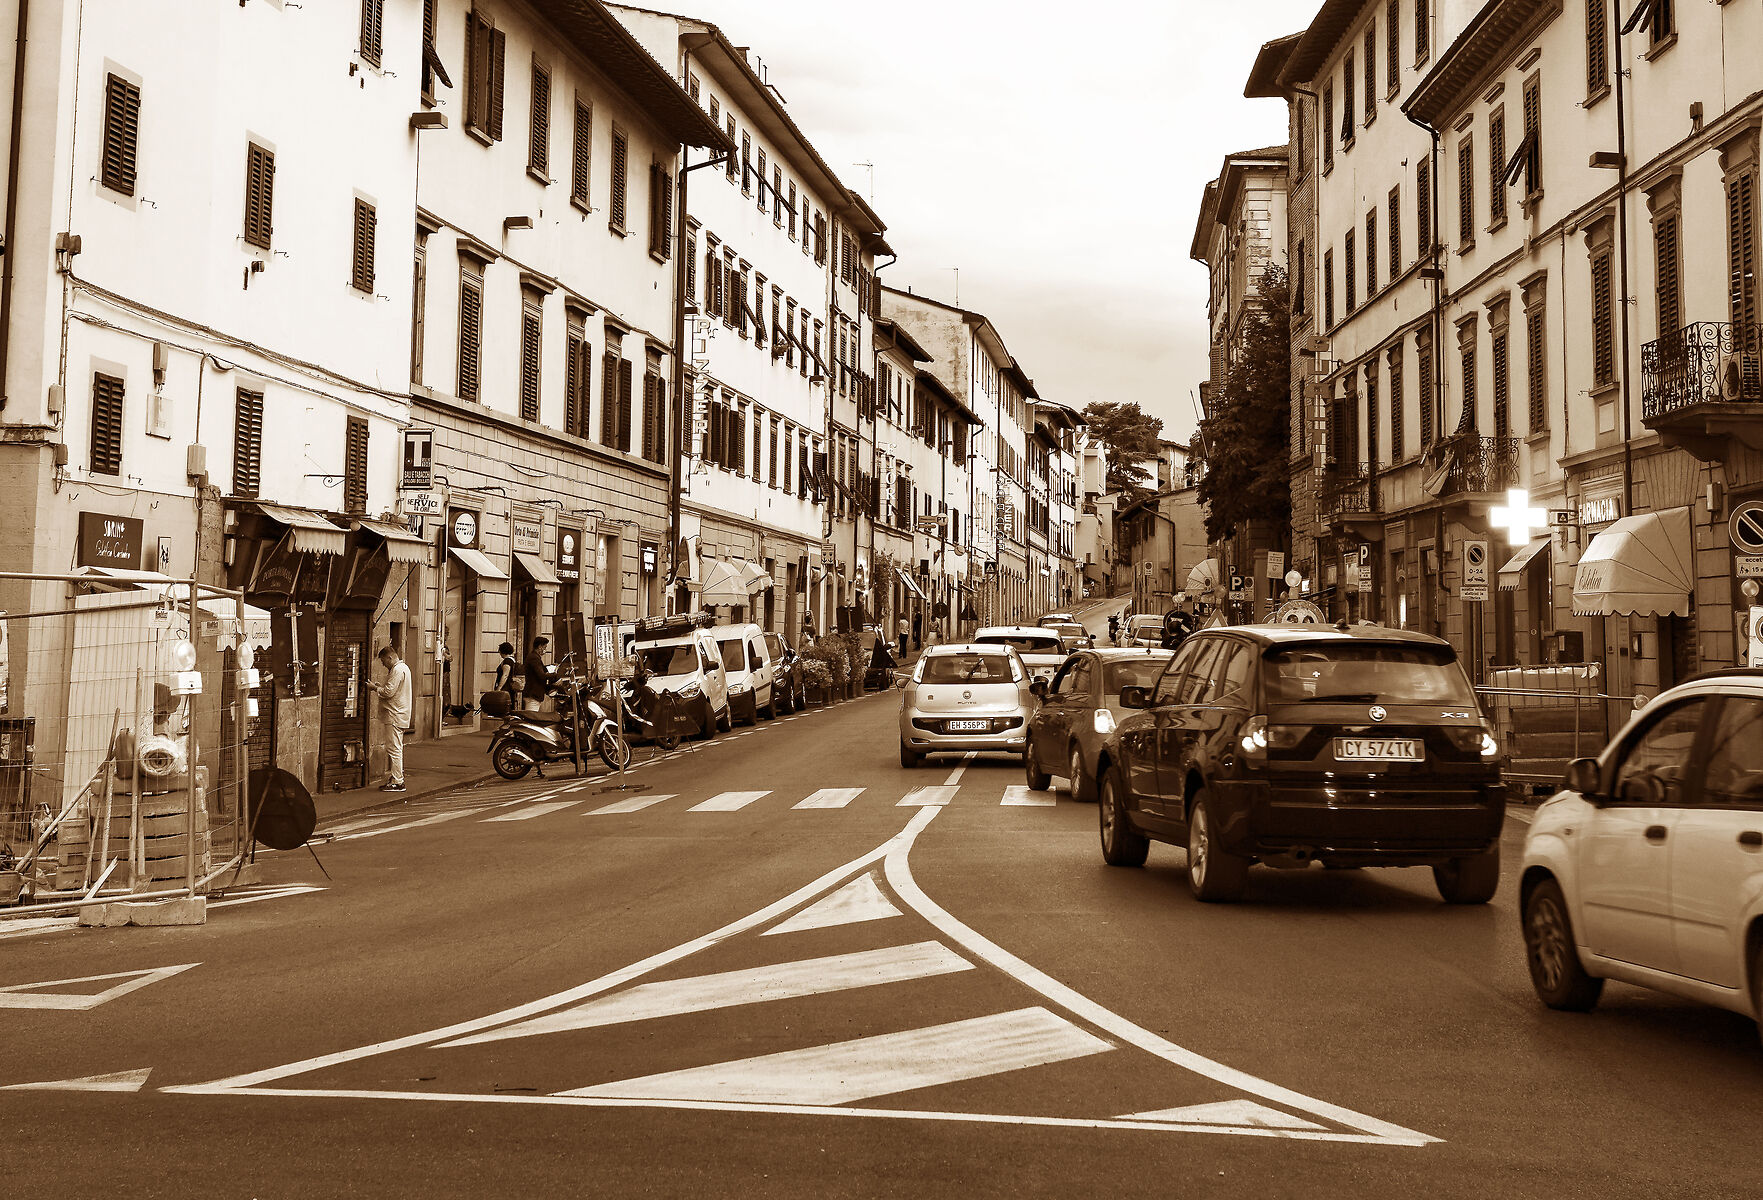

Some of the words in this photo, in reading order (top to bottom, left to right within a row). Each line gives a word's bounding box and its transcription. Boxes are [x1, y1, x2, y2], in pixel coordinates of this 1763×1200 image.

[691, 319, 711, 476] PIZZERIA
[407, 434, 431, 467] T
[407, 498, 438, 508] SERVICE
[1578, 498, 1614, 525] FARMACIA
[1361, 545, 1369, 565] P
[1229, 565, 1236, 575] P
[1231, 577, 1243, 591] P
[1440, 711, 1469, 719] X3
[1344, 740, 1365, 756] CY
[1368, 741, 1413, 757] 574TK
